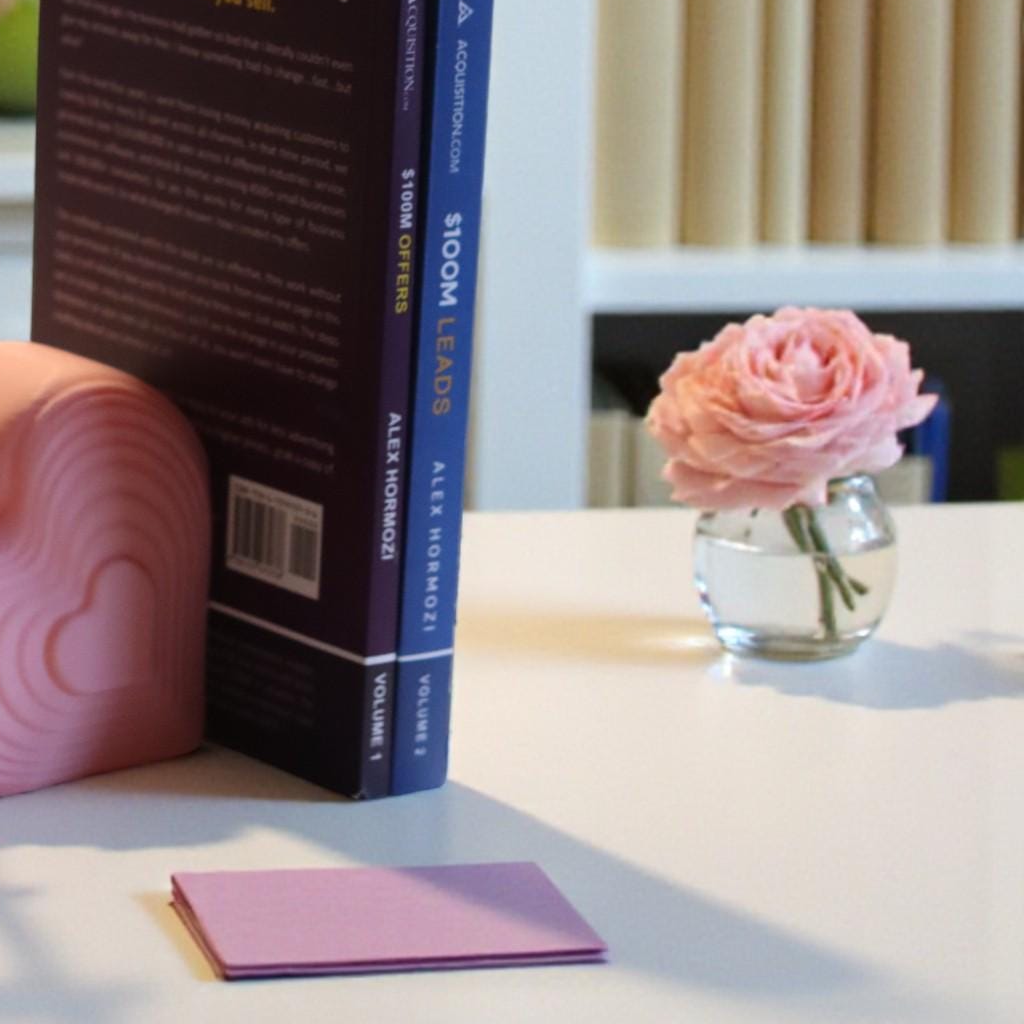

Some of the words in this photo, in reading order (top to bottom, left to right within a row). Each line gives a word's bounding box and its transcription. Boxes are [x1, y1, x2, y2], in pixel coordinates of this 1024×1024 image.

[449, 39, 469, 174] ACQUISITION.COM
[399, 168, 416, 229] $100M
[395, 234, 412, 314] OFFERS
[438, 212, 463, 307] $100M
[432, 317, 456, 415] LEADS
[386, 412, 402, 464] ALEX
[380, 469, 399, 560] HORMOZI
[429, 460, 446, 517] ALEX
[422, 527, 442, 632] HORMOZI
[369, 672, 387, 748] VOLUME
[414, 673, 431, 743] VOLUME
[369, 752, 383, 761] 1
